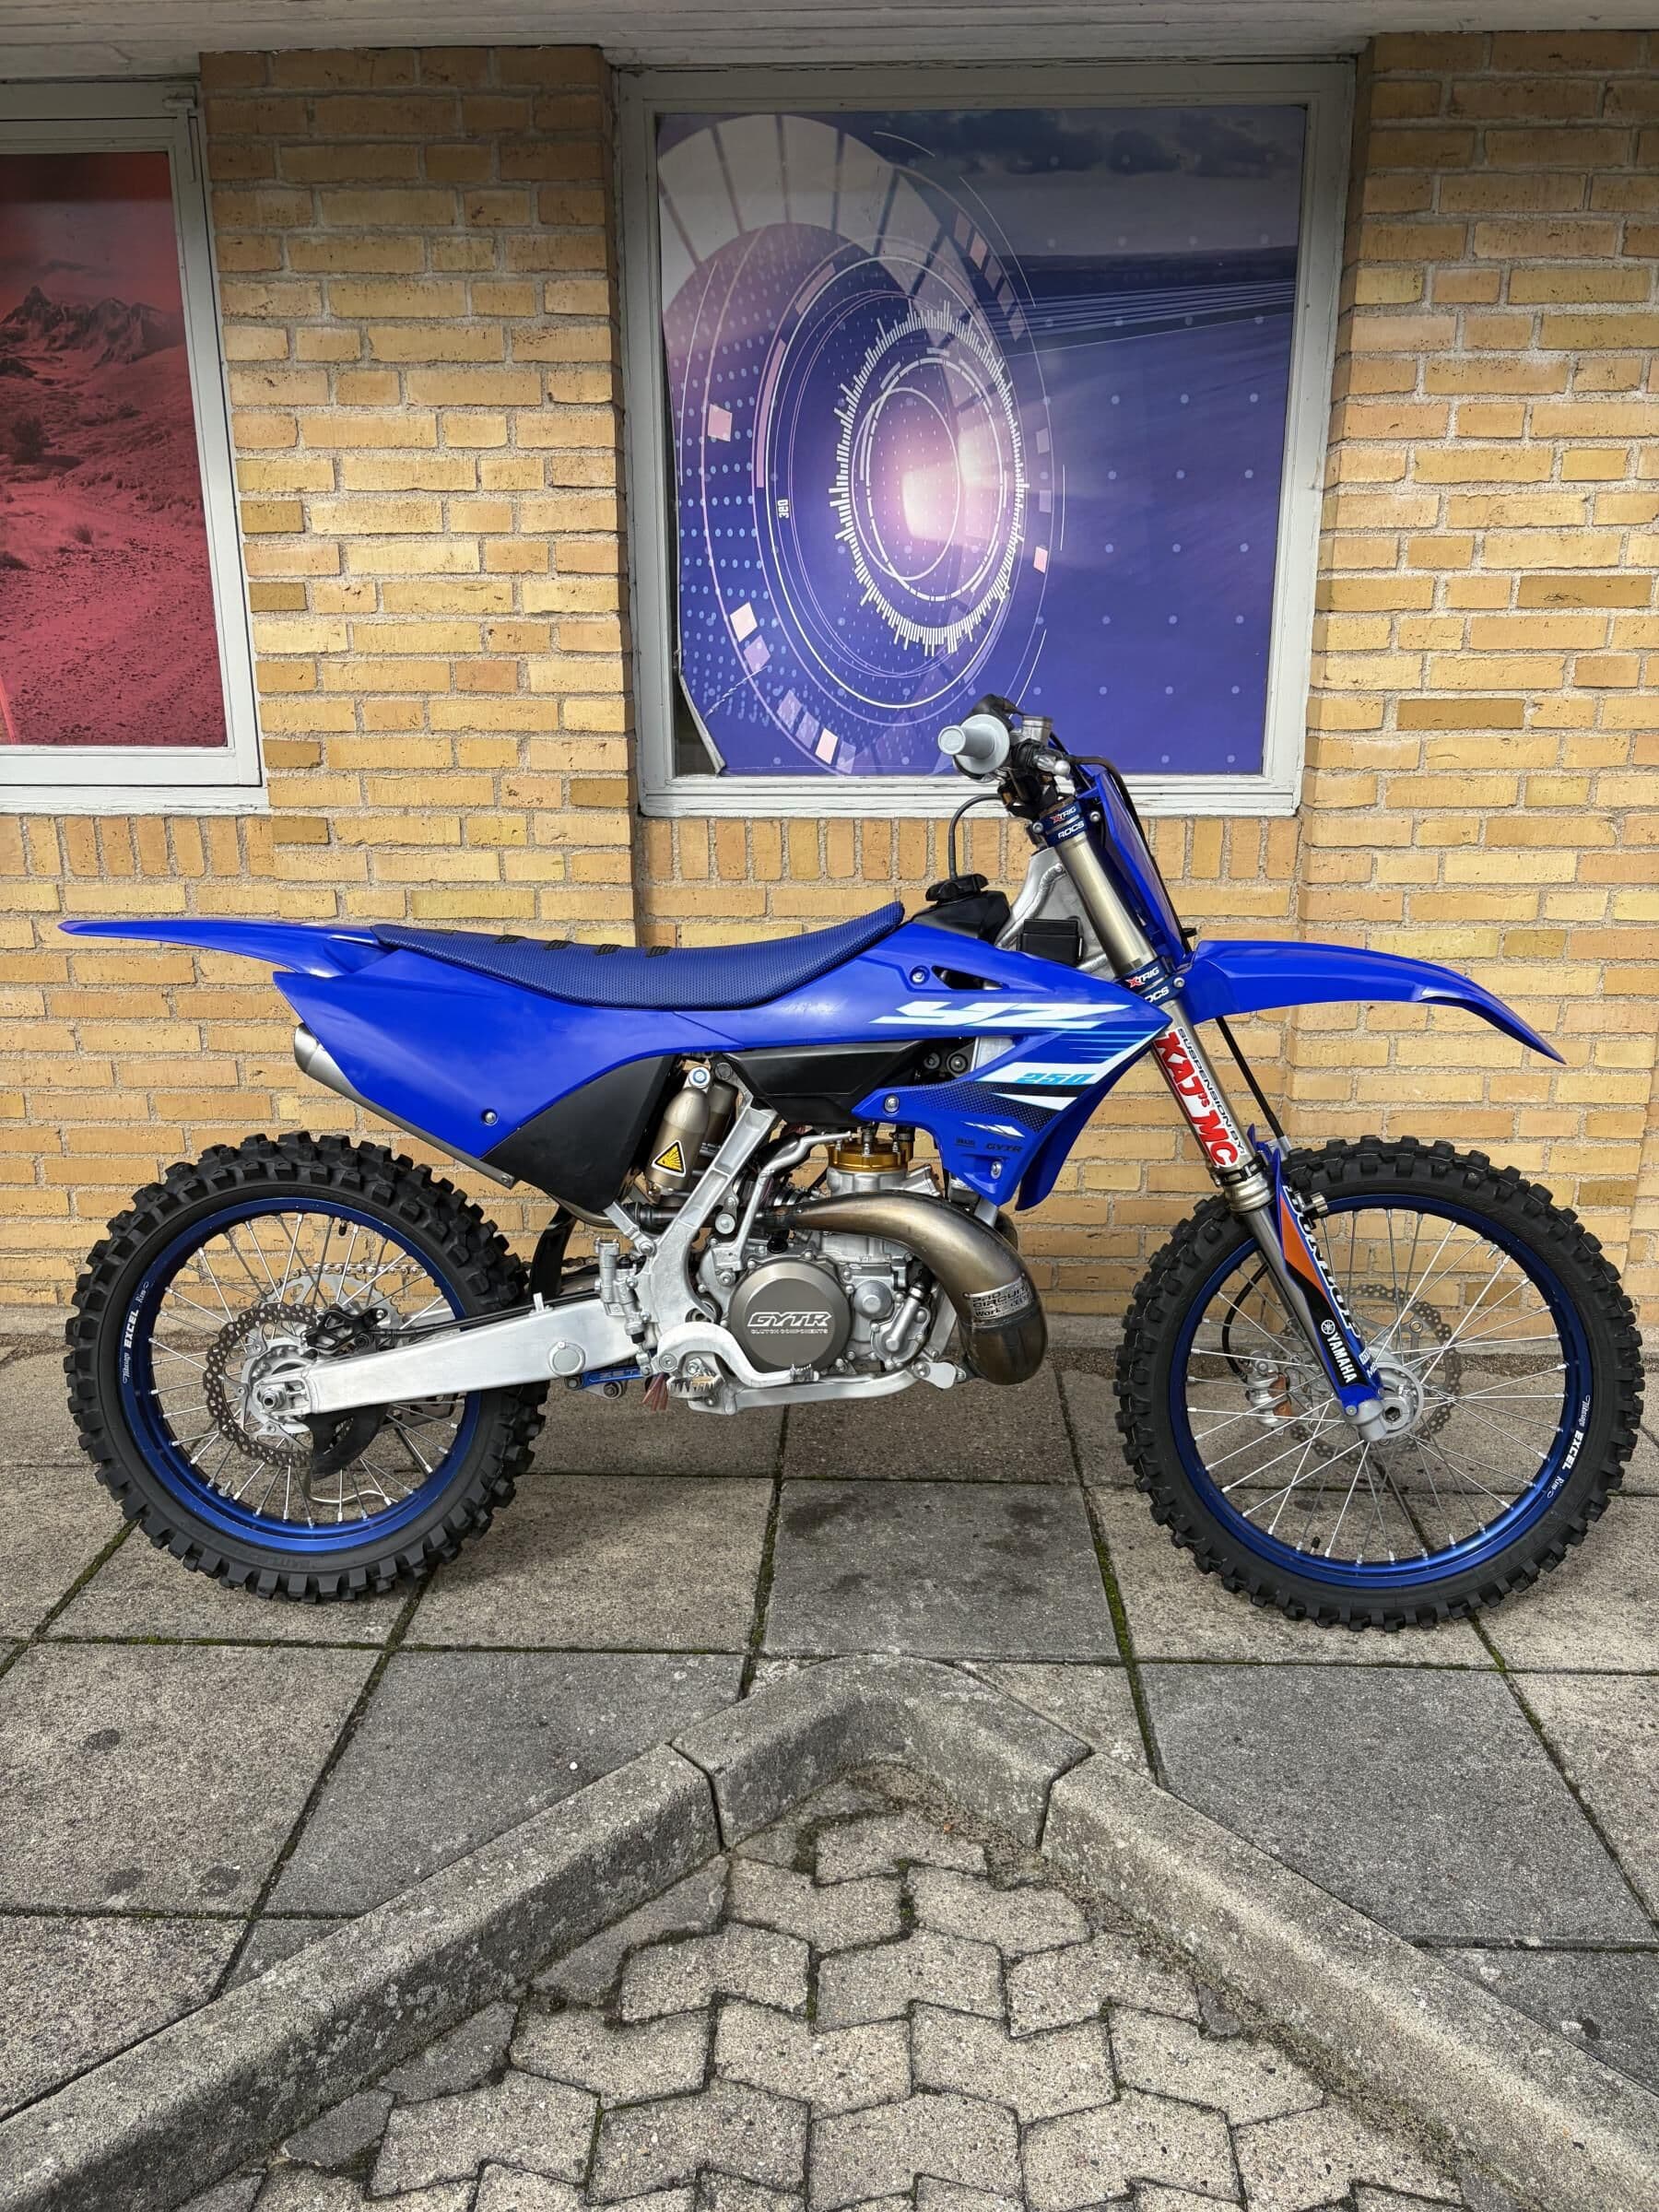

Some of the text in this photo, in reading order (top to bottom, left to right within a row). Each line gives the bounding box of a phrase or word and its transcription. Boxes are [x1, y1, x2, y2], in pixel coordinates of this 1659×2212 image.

[1049, 806, 1077, 824] XTRIG
[1057, 820, 1085, 839] ROCS
[1125, 966, 1159, 988] XTRIG
[1144, 986, 1170, 1003] OCS
[868, 1001, 1133, 1030] YZ
[1015, 1072, 1097, 1085] 250
[1179, 1028, 1232, 1128] SUSPENSION
[1191, 1109, 1239, 1166] MC
[124, 1309, 139, 1348] EXCEL
[747, 1312, 832, 1327] GYTR
[1327, 1332, 1358, 1383] YAMAHA
[1562, 1430, 1584, 1470] EXCEL
